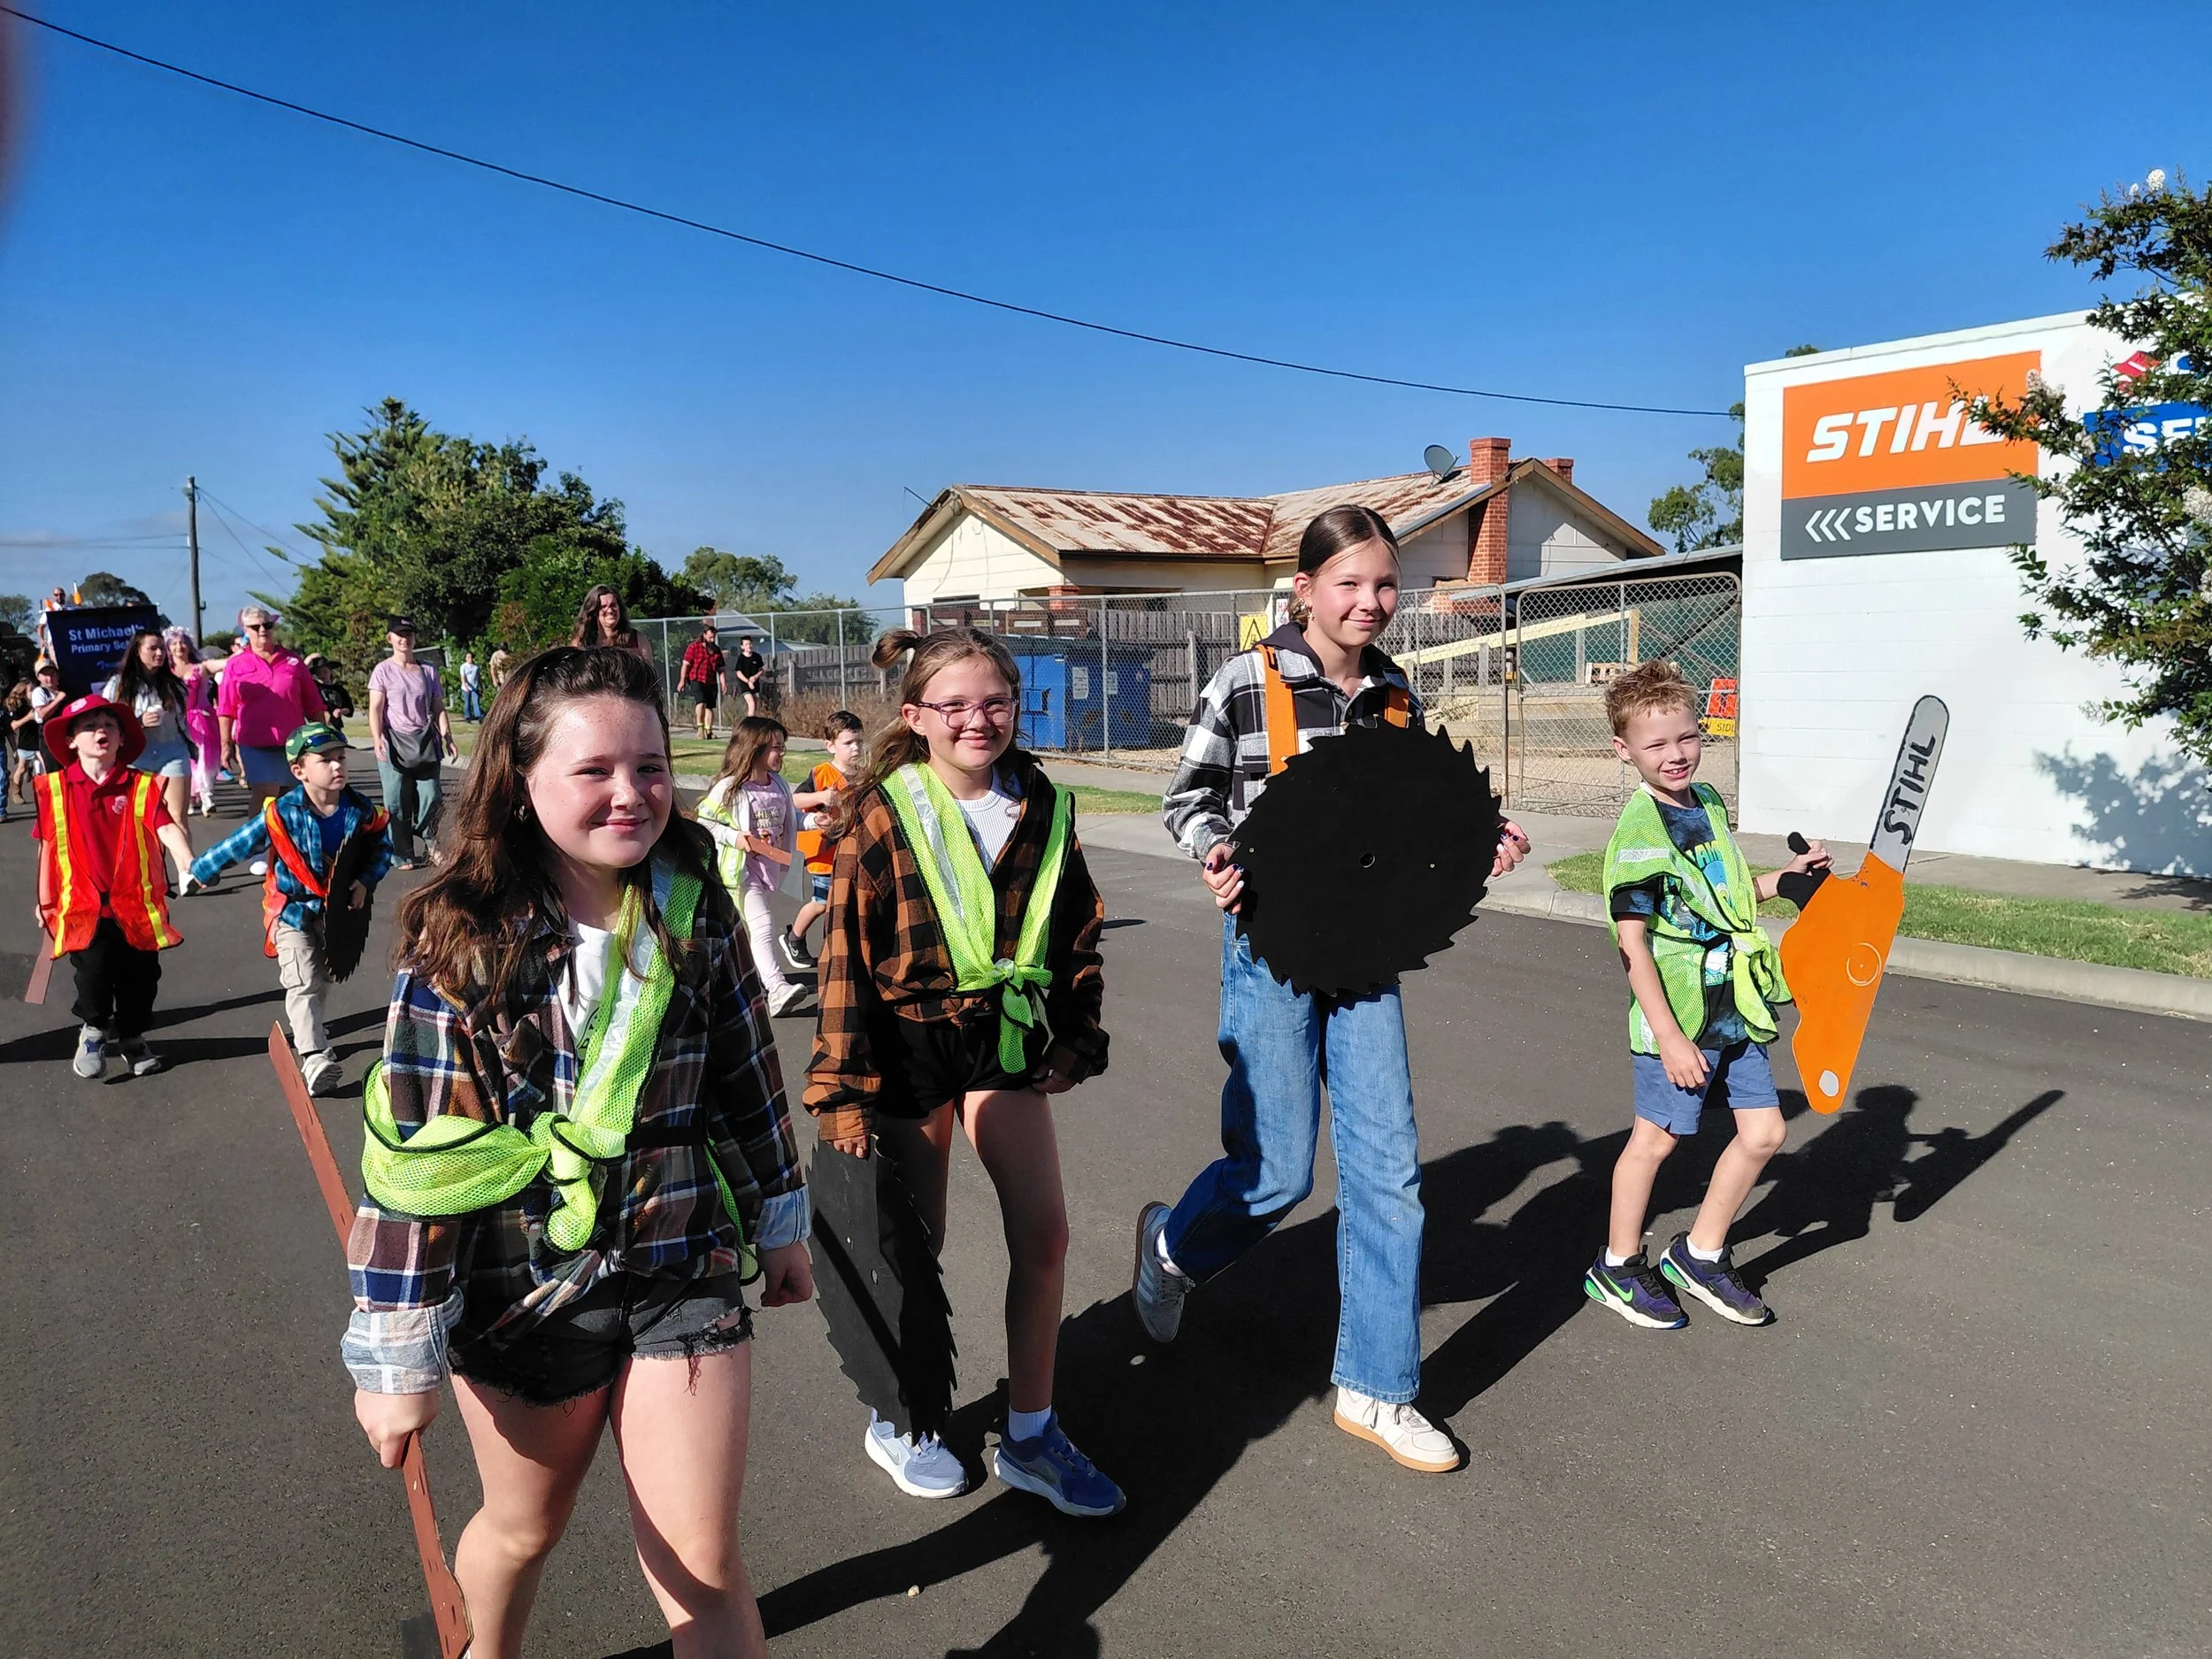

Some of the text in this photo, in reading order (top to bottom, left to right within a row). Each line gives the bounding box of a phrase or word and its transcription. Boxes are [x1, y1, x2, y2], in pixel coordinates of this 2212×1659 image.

[1805, 396, 2007, 464] STIHL
[1854, 494, 2006, 534] SERVICE
[68, 629, 82, 641] St
[72, 642, 111, 654] Primary
[1884, 734, 1936, 846] STIHL
